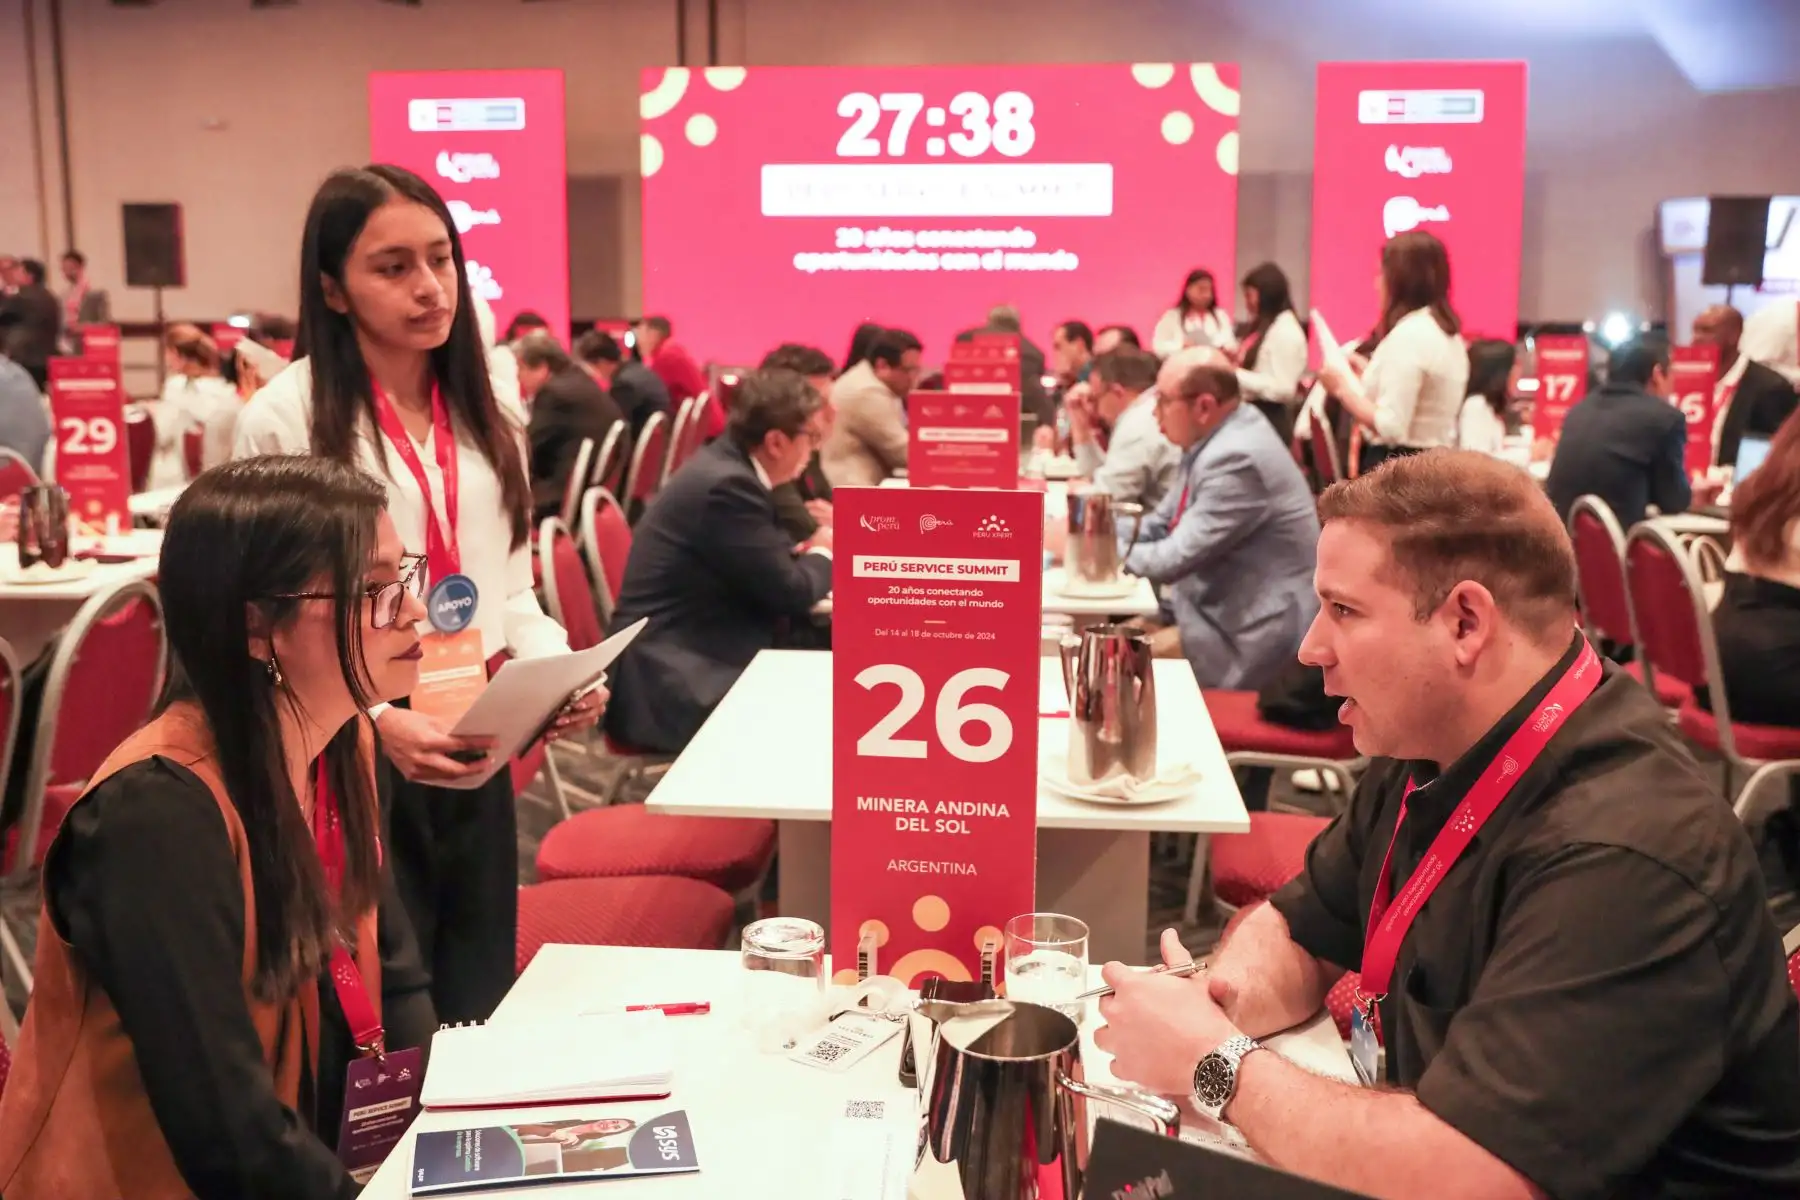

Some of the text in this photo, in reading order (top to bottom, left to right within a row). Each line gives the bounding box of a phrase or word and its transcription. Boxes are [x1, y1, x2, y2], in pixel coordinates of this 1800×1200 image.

[836, 91, 1036, 157] 27:38
[1543, 374, 1577, 402] 17
[60, 416, 117, 454] 29
[863, 560, 1008, 576] PERÚ SERVICE SUMMIT
[888, 585, 984, 597] 20 años conectando
[438, 596, 472, 613] APOYO
[867, 596, 1004, 608] oportunidades con el mundo
[874, 628, 888, 636] Del
[901, 629, 908, 637] al
[910, 630, 920, 638] 18
[920, 630, 931, 638] de
[932, 631, 962, 639] octubre
[964, 632, 975, 640] de
[976, 632, 996, 640] 2024
[853, 663, 1014, 763] 26
[857, 796, 1010, 818] MINERA ANDINA
[896, 817, 970, 834] DEL SOL
[886, 859, 978, 876] ARGENTINA
